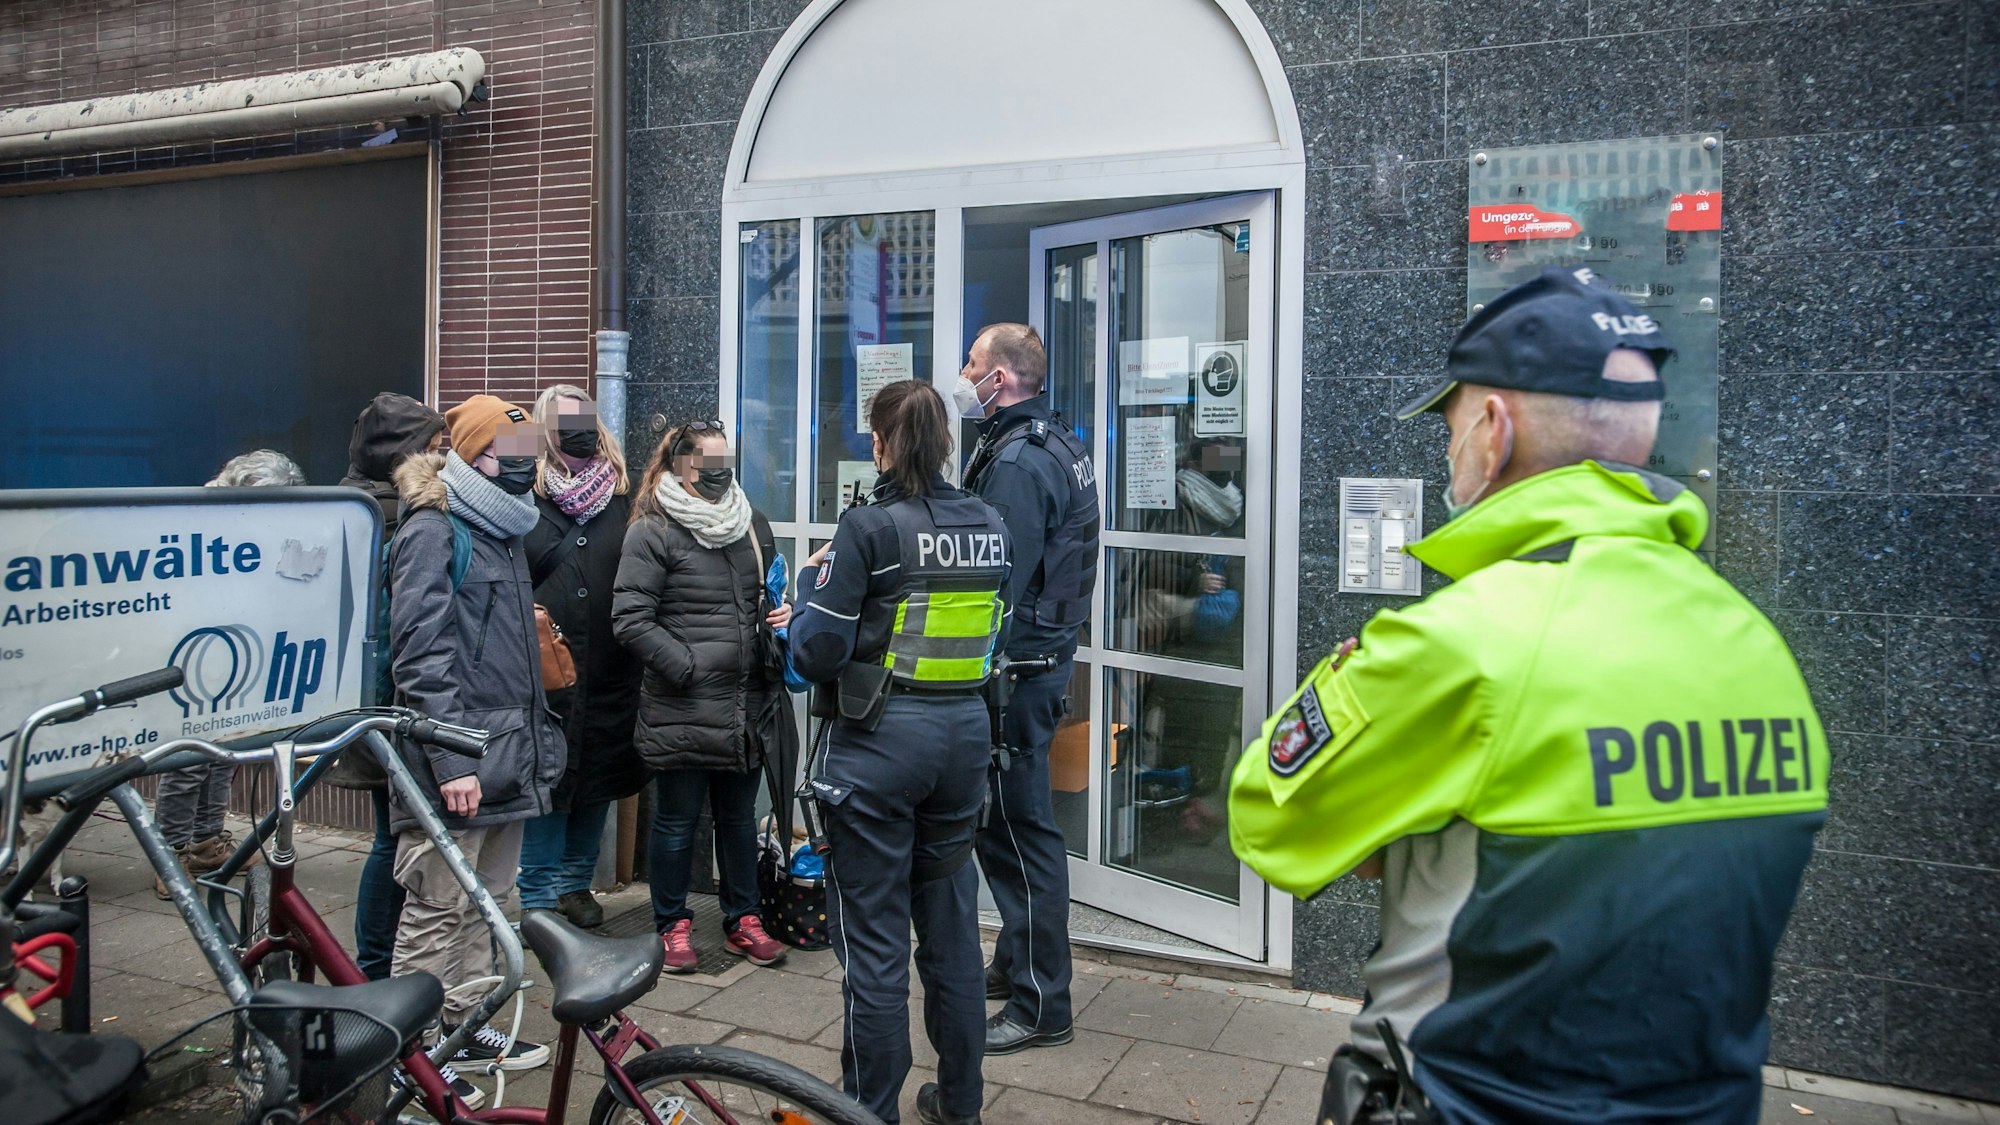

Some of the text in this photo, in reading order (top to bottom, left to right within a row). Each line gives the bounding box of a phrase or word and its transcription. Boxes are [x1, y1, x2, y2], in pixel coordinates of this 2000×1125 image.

[5, 533, 262, 592] anwälte
[917, 533, 1005, 567] POLIZEI
[2, 592, 172, 627] Arbeitsrecht
[264, 631, 327, 715] hp
[182, 704, 288, 737] Rechtsanwälte
[1586, 718, 1812, 808] POLIZEI
